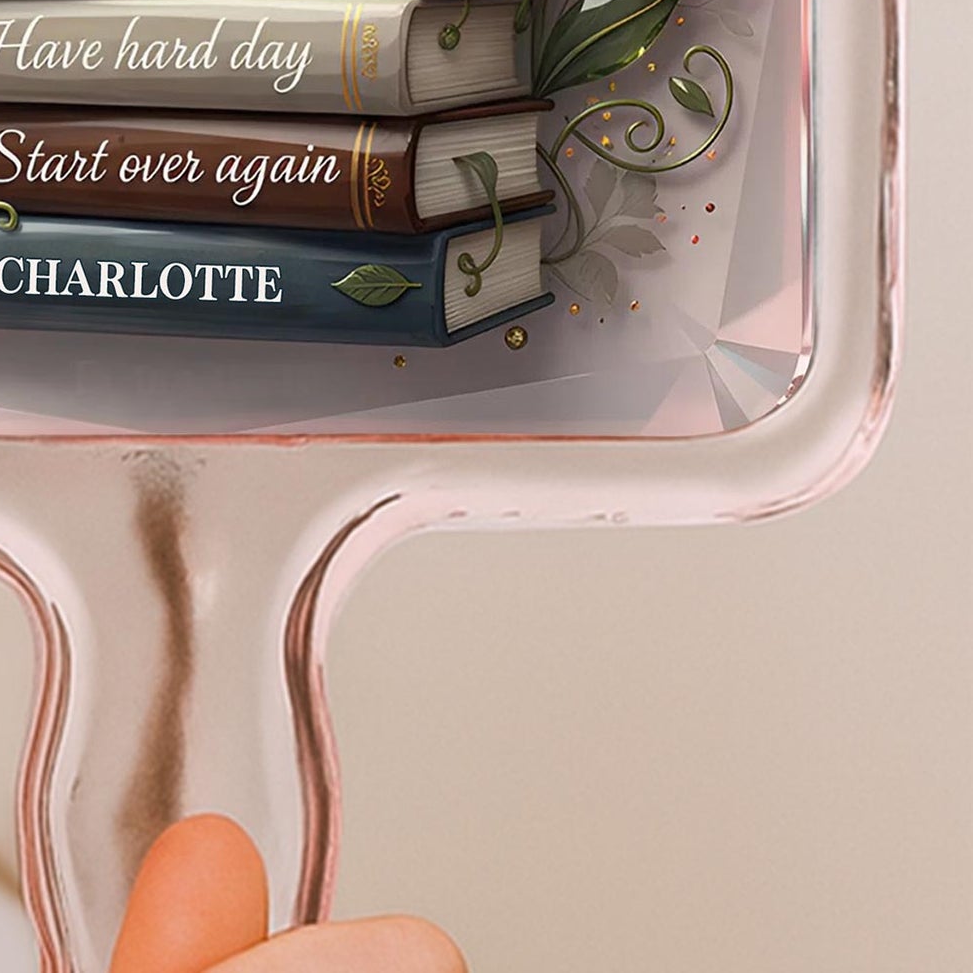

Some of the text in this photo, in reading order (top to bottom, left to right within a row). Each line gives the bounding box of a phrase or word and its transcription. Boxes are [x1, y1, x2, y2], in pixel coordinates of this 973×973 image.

[114, 16, 224, 70] hard
[230, 17, 312, 92] day
[119, 150, 205, 183] over
[216, 146, 341, 205] again
